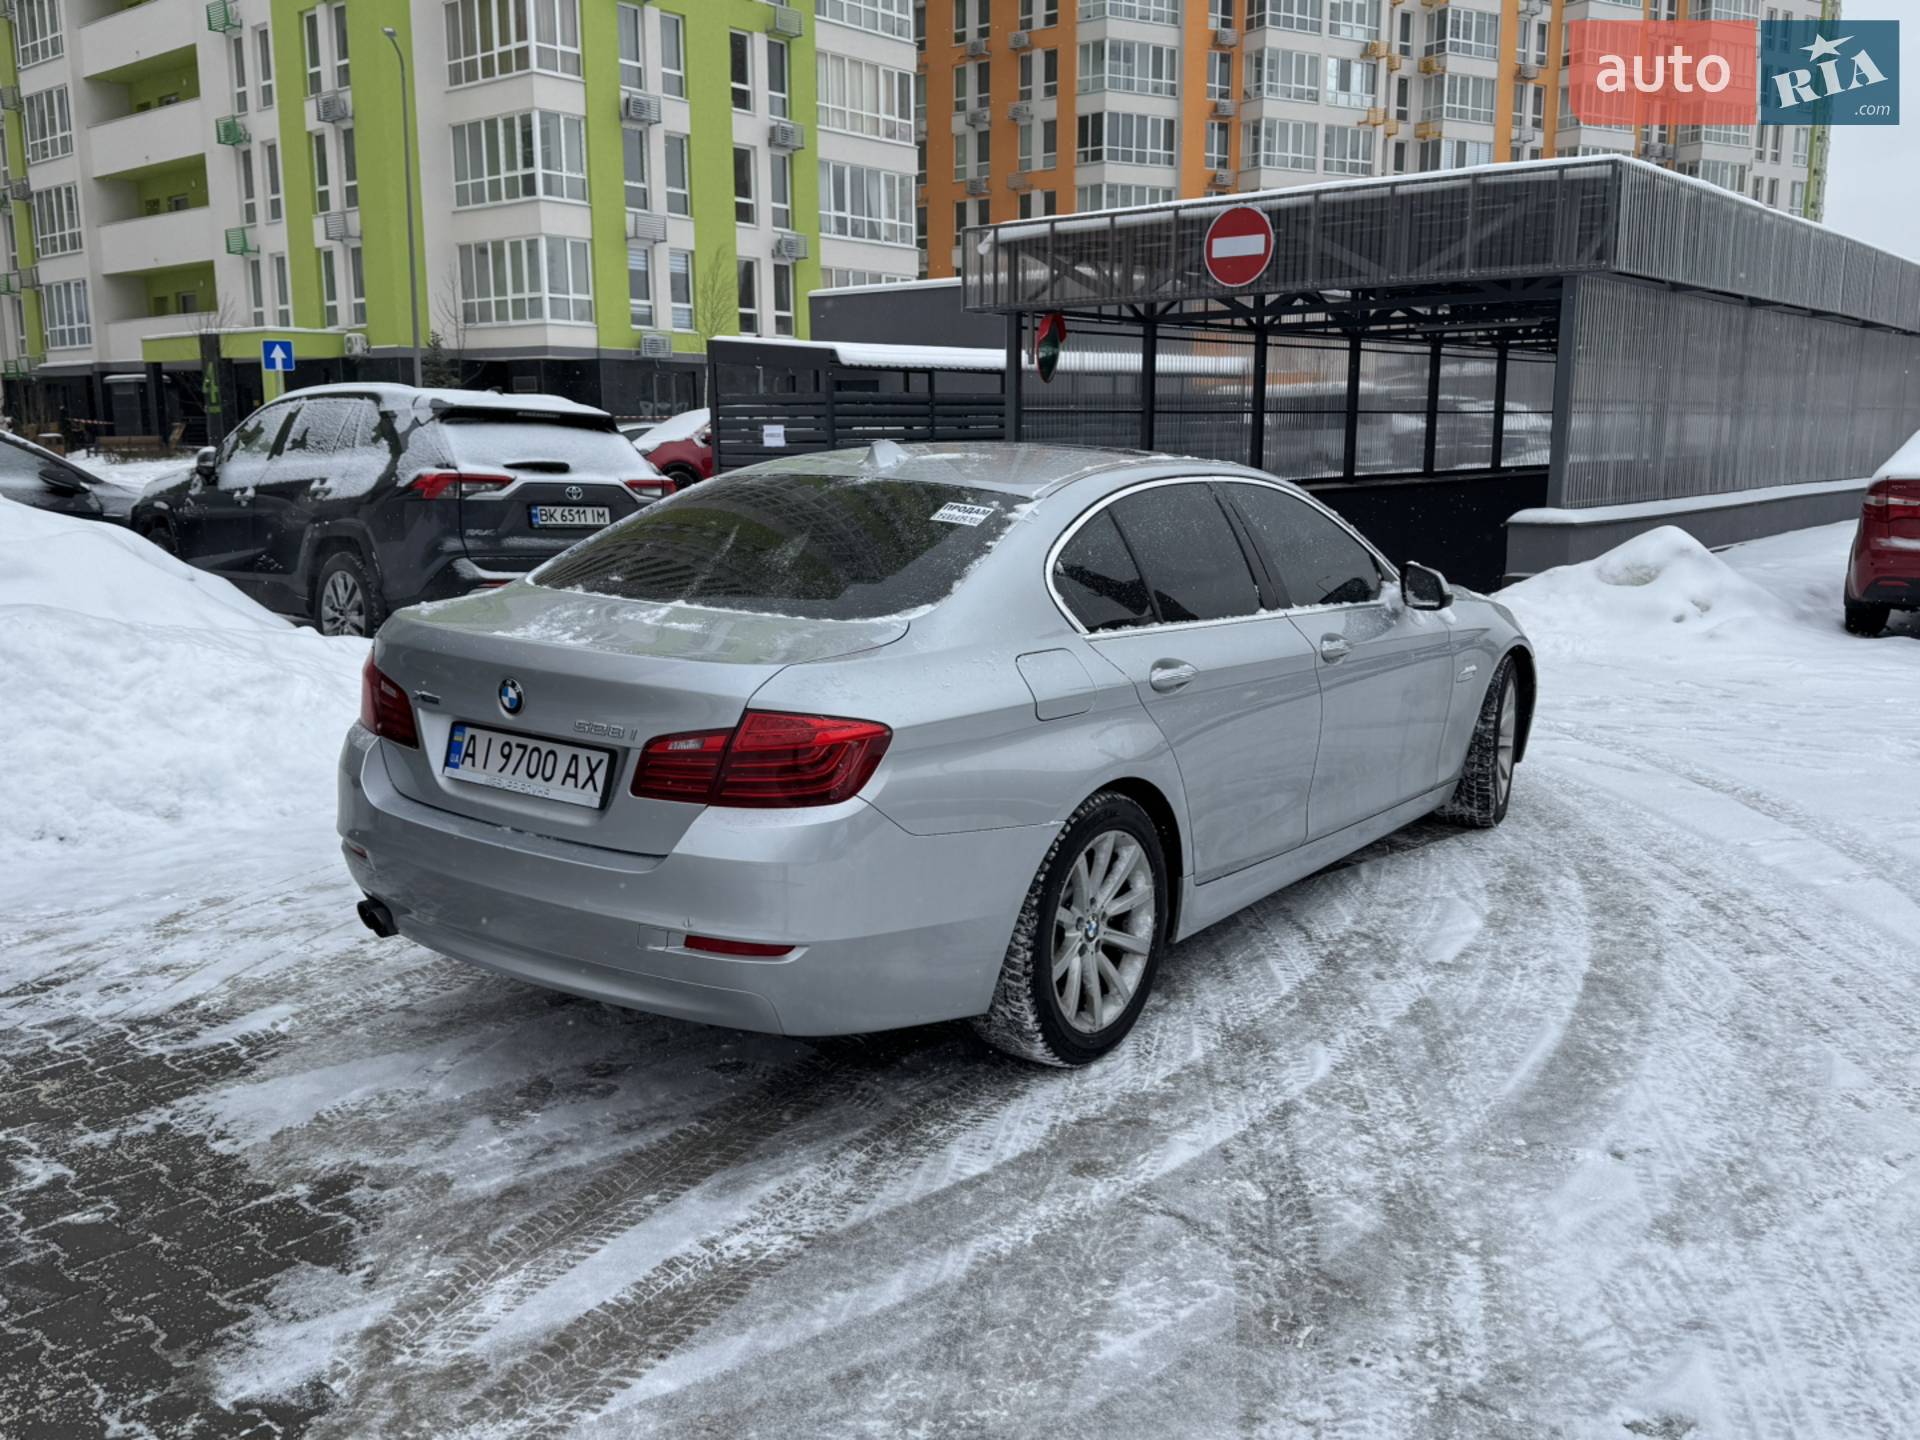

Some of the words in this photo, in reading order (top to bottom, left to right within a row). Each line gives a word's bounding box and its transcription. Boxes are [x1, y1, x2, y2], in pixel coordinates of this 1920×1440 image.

[539, 508, 559, 523] BK
[560, 508, 588, 523] 6511
[591, 508, 606, 523] IM
[943, 503, 992, 516] ПРОДАМ
[461, 734, 492, 770] AI
[498, 741, 558, 782] 9700
[561, 754, 604, 792] AX
